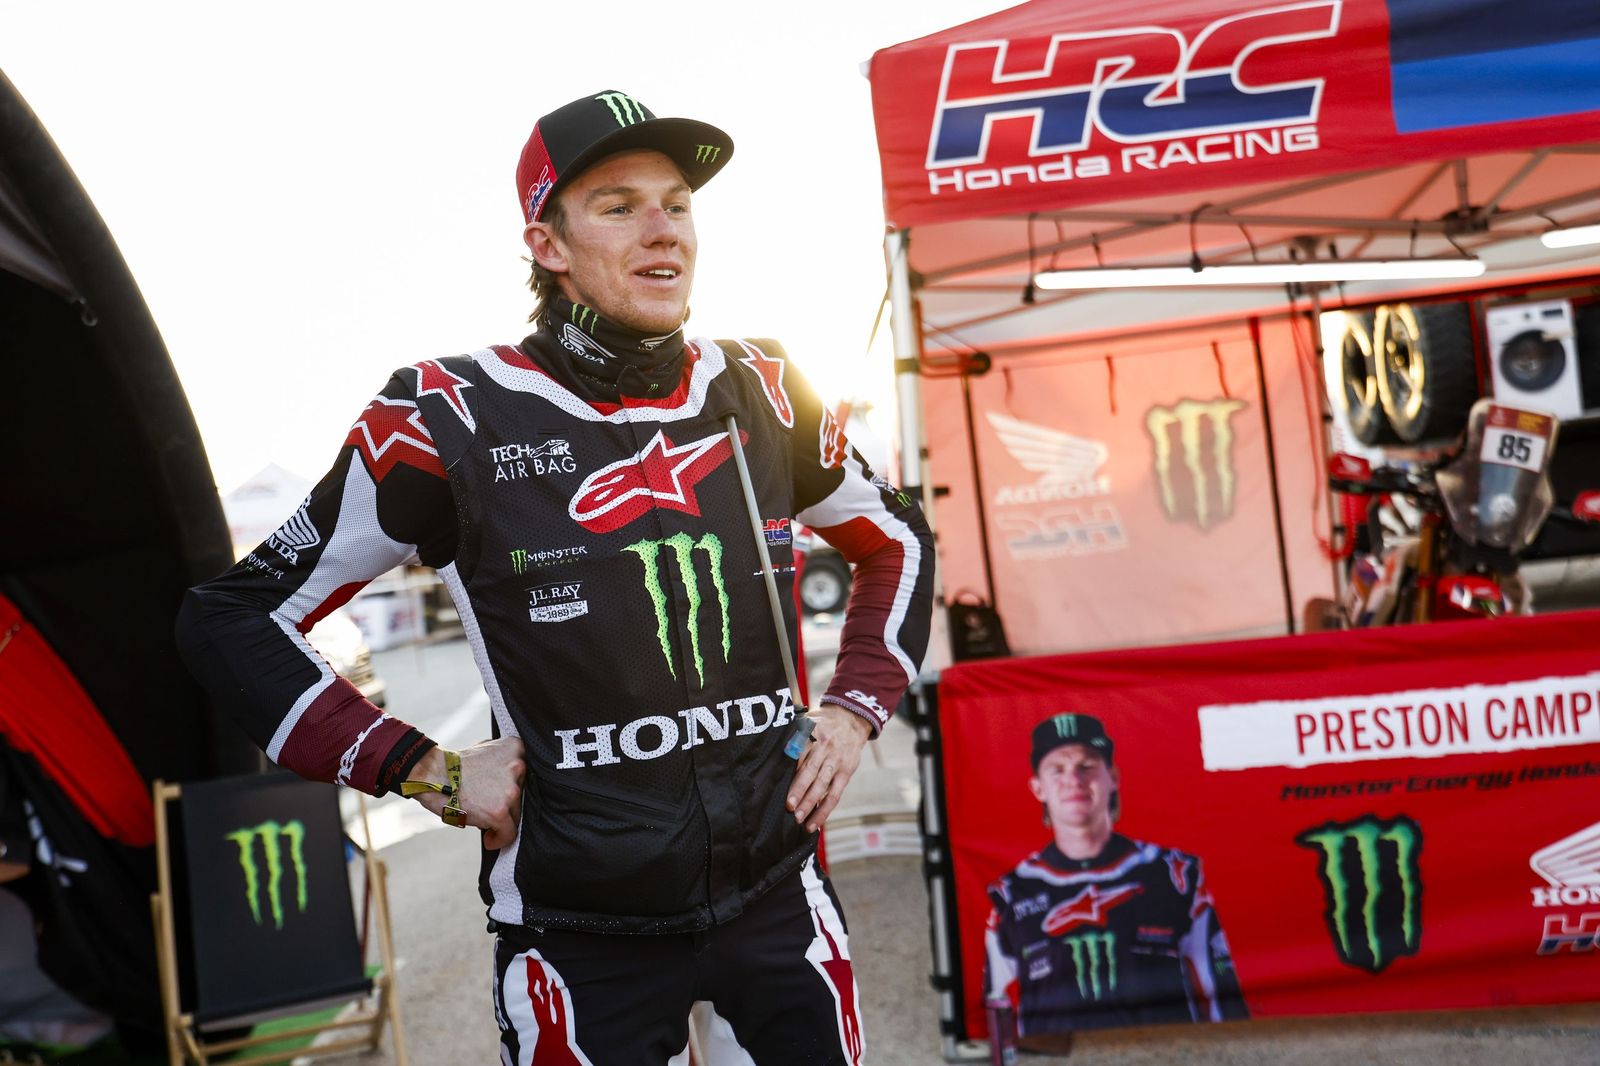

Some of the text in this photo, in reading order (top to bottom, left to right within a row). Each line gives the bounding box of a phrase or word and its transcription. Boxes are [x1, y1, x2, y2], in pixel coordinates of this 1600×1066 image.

[925, 0, 1342, 169] HRC
[929, 126, 1319, 195] Honda RACING
[489, 443, 531, 463] TECH
[1498, 433, 1532, 463] 85
[494, 456, 577, 483] AIR BAG
[528, 545, 588, 562] MONSTER
[554, 687, 796, 770] HONDA
[1294, 691, 1600, 756] PRESTON CAMP
[1281, 774, 1400, 801] Monster
